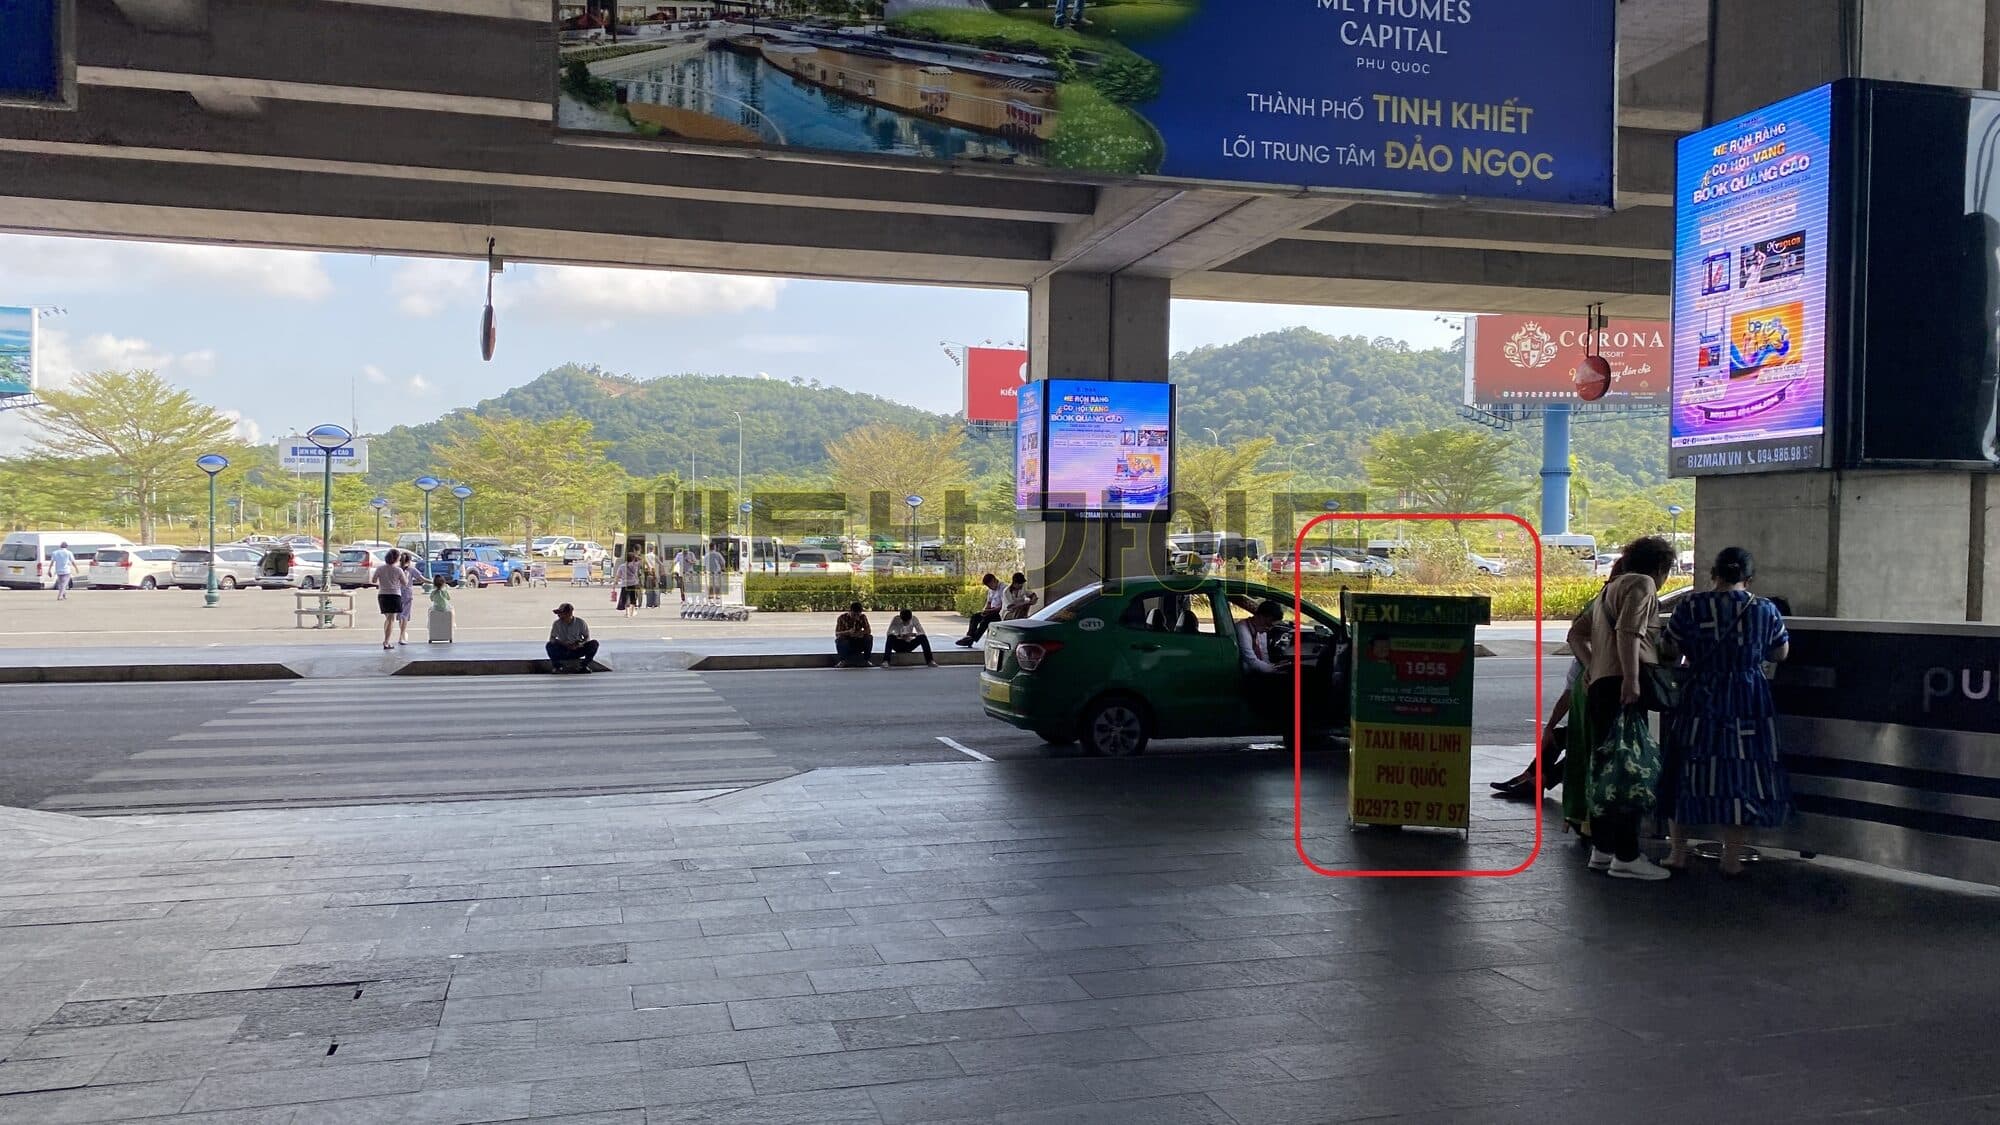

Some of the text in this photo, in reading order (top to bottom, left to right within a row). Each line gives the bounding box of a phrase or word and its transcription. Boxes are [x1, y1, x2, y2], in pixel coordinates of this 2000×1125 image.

[1340, 20, 1448, 54] CAPITAL
[1356, 57, 1431, 74] PHU QUOC
[1246, 91, 1534, 134] THÀNH PHỐ TINH KHIẾT
[1222, 134, 1554, 186] LÕI TRUNG TÂM ĐẢO NGỌC
[1693, 181, 1729, 204] BOOK
[1559, 330, 1665, 348] CORONA
[1687, 450, 1742, 468] BIZMAN.VN
[1405, 661, 1447, 676] 1055
[1364, 729, 1461, 752] TAXI MAI LINH
[1355, 798, 1466, 823] 02973 97 97 97
